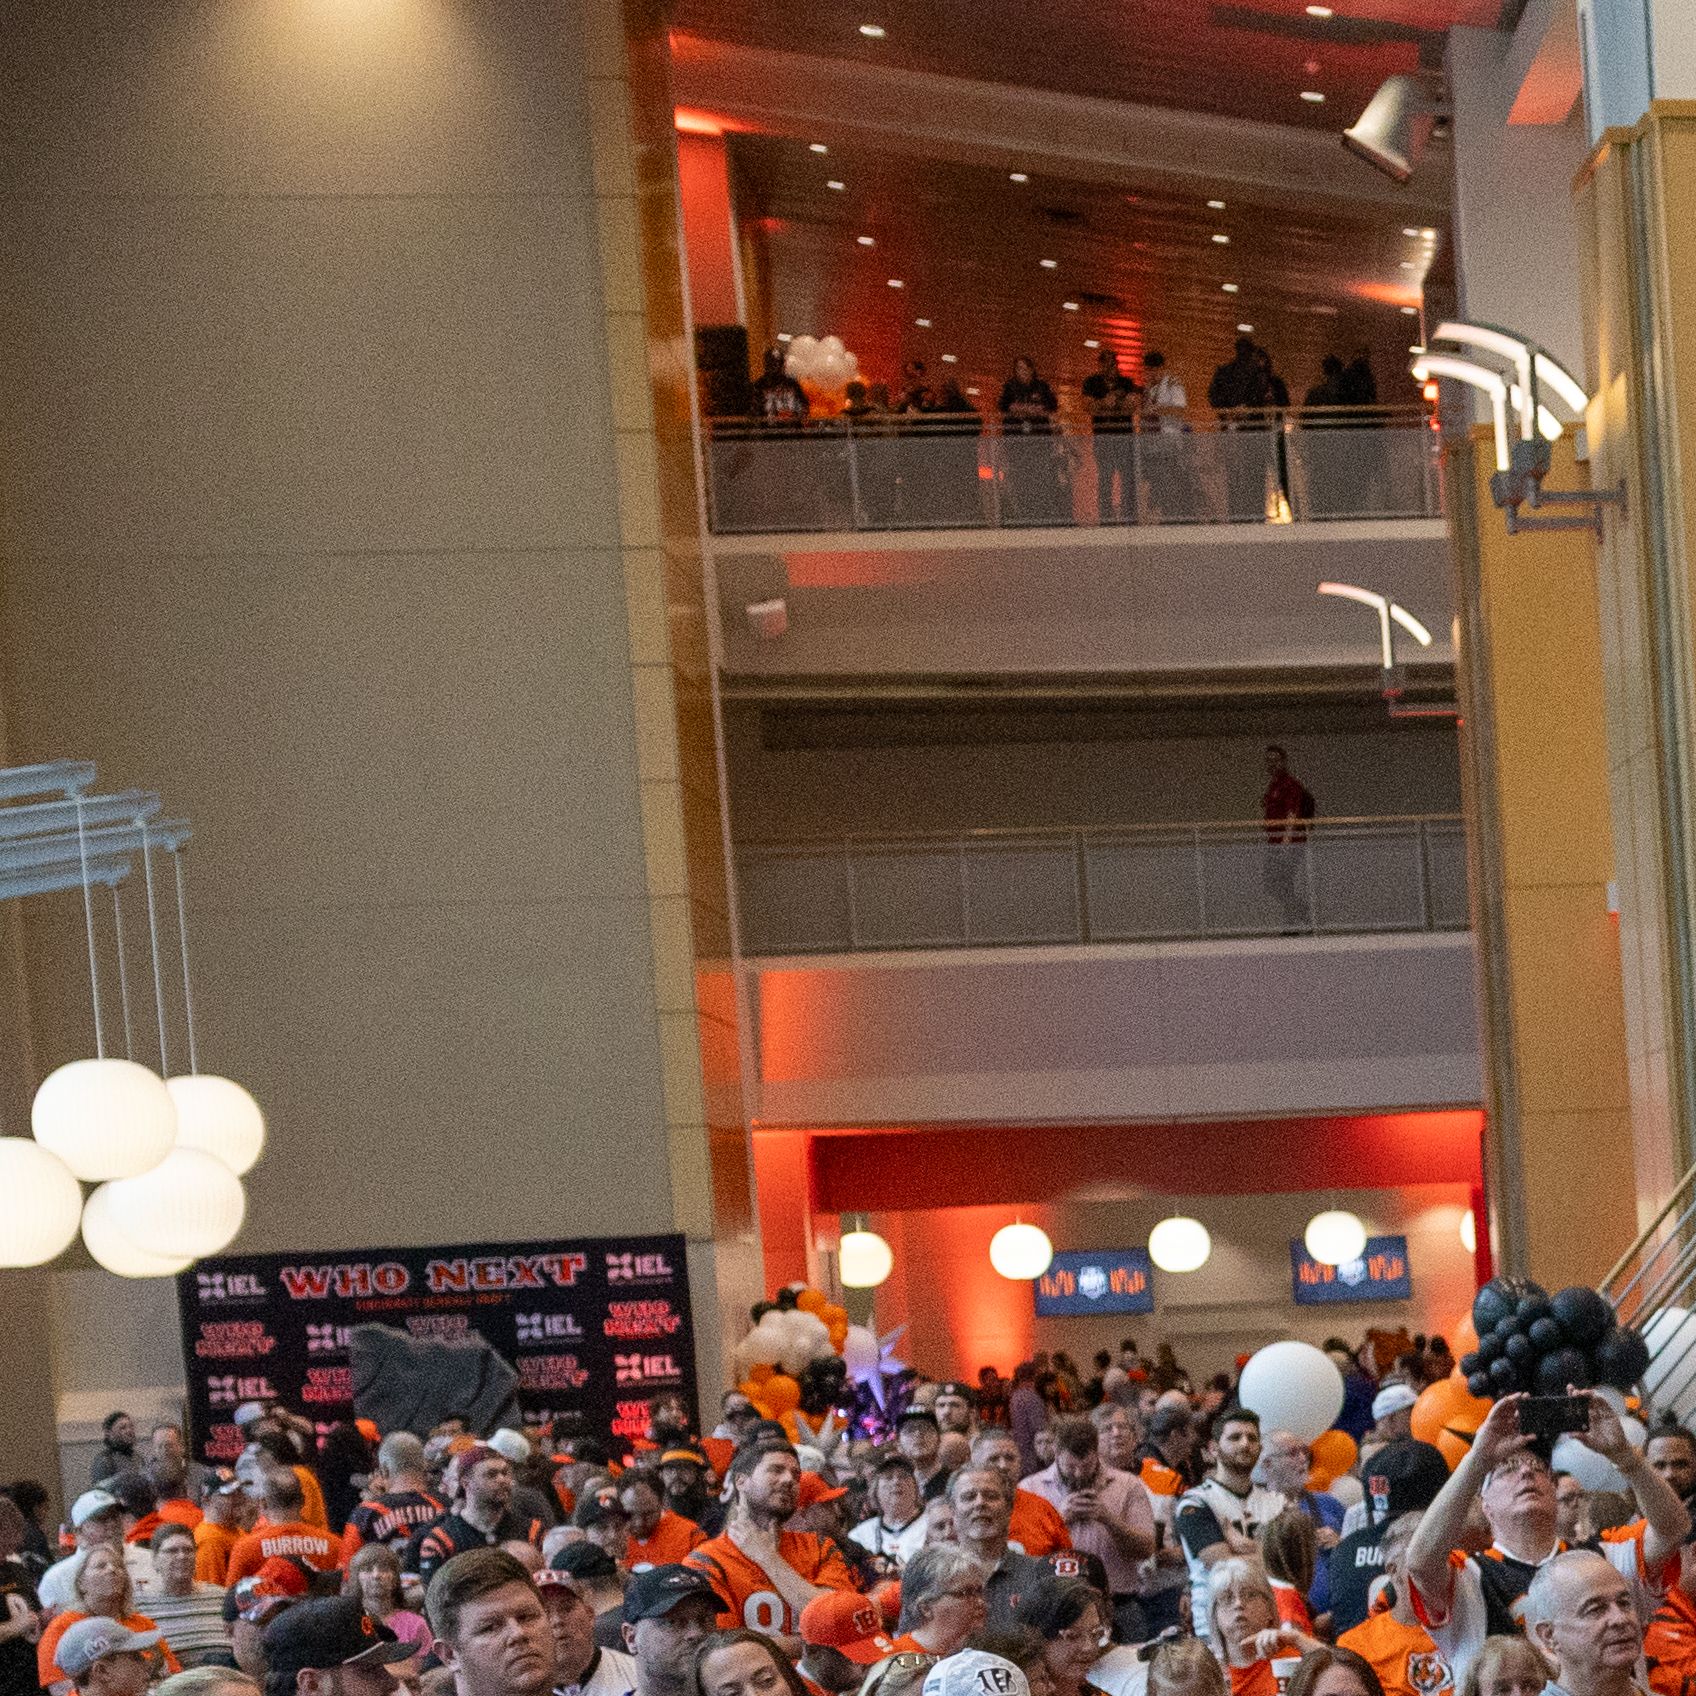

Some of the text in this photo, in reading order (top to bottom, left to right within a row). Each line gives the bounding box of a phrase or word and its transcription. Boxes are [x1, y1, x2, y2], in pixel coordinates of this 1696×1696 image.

[280, 1252, 587, 1300] WHO NEXT
[261, 1537, 329, 1559] BURROW
